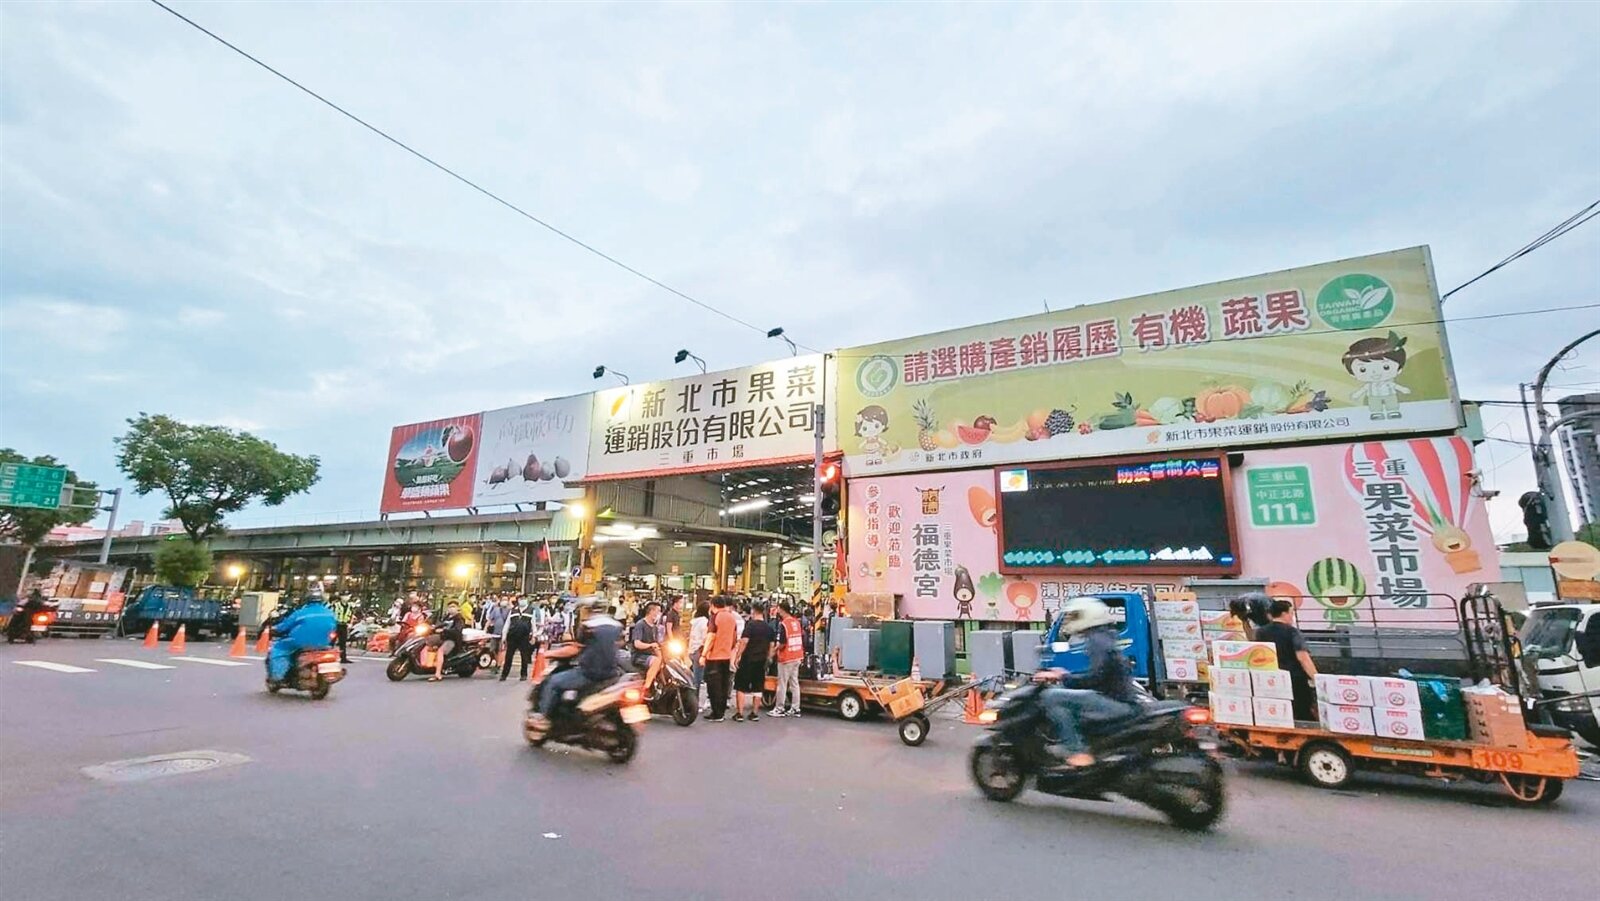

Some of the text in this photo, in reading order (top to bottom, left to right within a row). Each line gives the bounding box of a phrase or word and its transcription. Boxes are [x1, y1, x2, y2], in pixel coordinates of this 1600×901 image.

[1319, 299, 1361, 310] TAIWAN
[903, 290, 1305, 383] 請選購產銷履歷 有機 蔬果
[641, 365, 816, 419] 新北市果菜
[604, 401, 815, 455] 運銷股份有限公司
[1165, 416, 1350, 442] 新北市果菜運銷股份有限公司
[659, 444, 744, 465] 三重市場
[925, 448, 983, 463] 新北市政府
[1117, 459, 1219, 484] 防疫管制公告
[1354, 458, 1409, 477] 三重
[1256, 488, 1305, 500] 中正北路
[1364, 482, 1428, 609] 果菜市場
[912, 523, 940, 598] 福德宮
